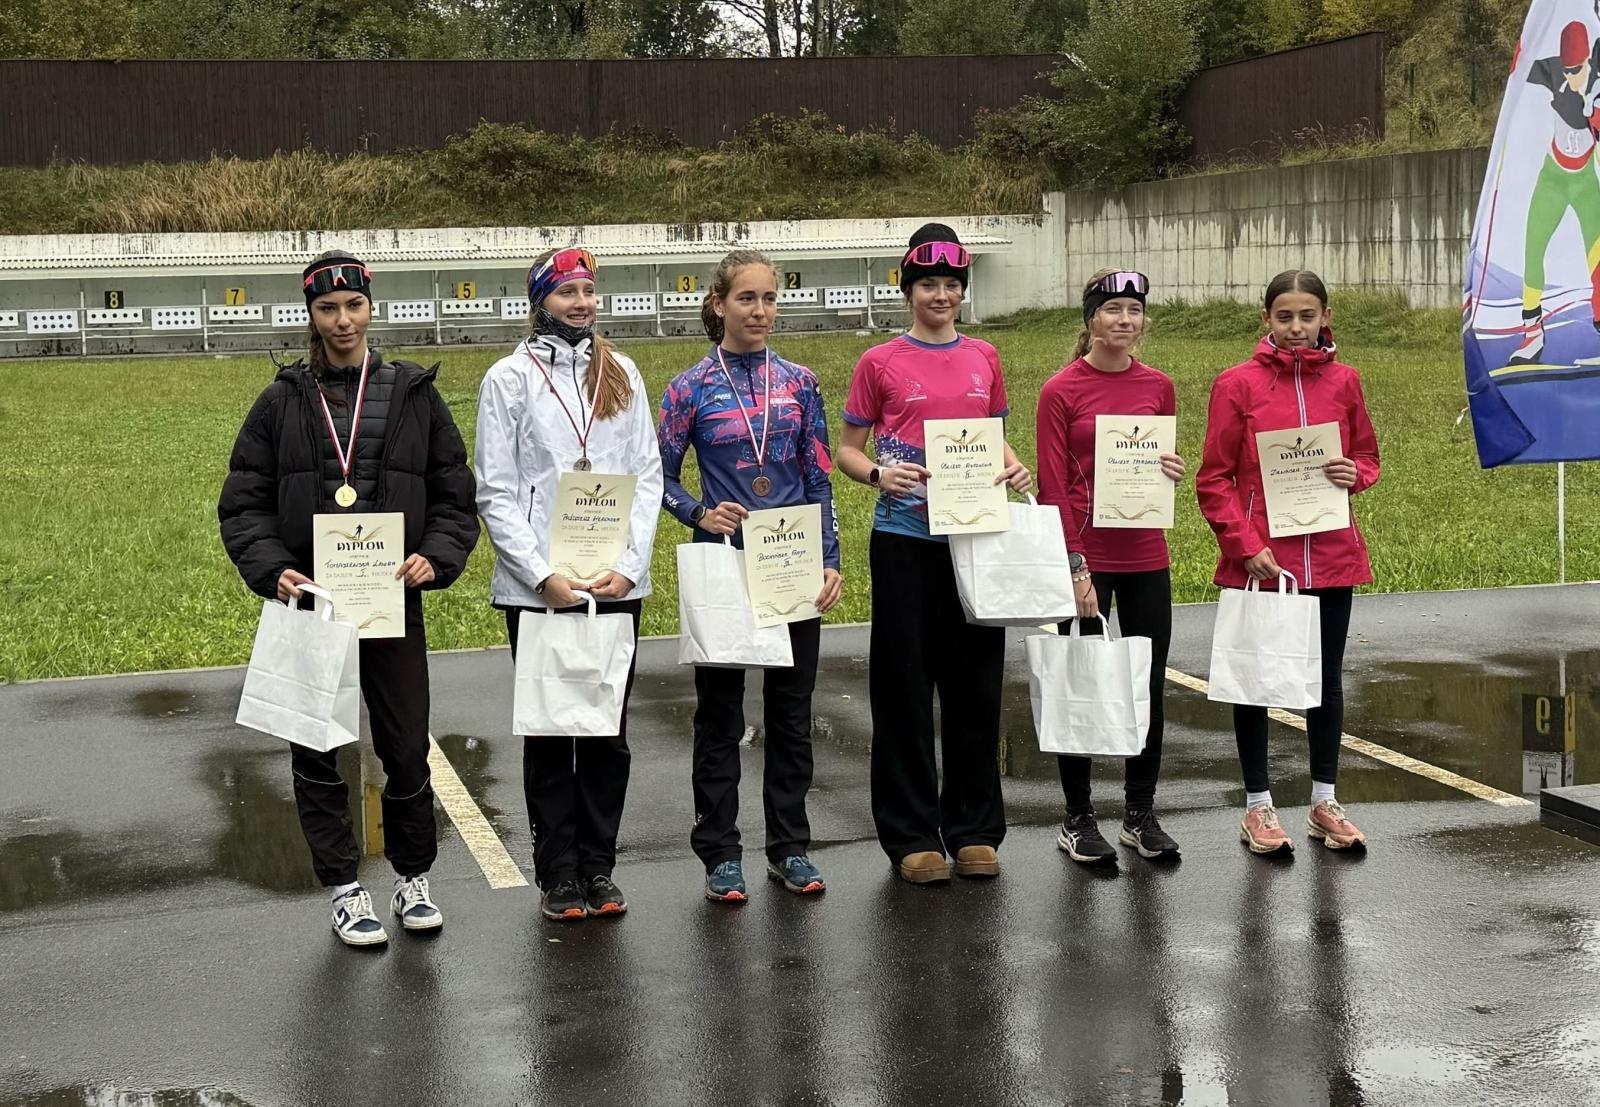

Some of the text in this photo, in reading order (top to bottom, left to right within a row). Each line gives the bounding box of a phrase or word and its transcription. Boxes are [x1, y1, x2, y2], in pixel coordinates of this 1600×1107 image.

[682, 277, 690, 292] 3
[789, 273, 798, 289] 2
[892, 270, 899, 285] 1
[230, 289, 239, 305] 7
[463, 283, 471, 298] 5
[109, 292, 119, 309] 8
[945, 444, 987, 453] DYPLOM
[1116, 440, 1158, 449] DYPLOM
[1280, 448, 1324, 460] DYPLOM
[575, 497, 616, 507] DYPLOM
[763, 531, 805, 544] DYPLOM
[337, 541, 385, 551] DYPLOM
